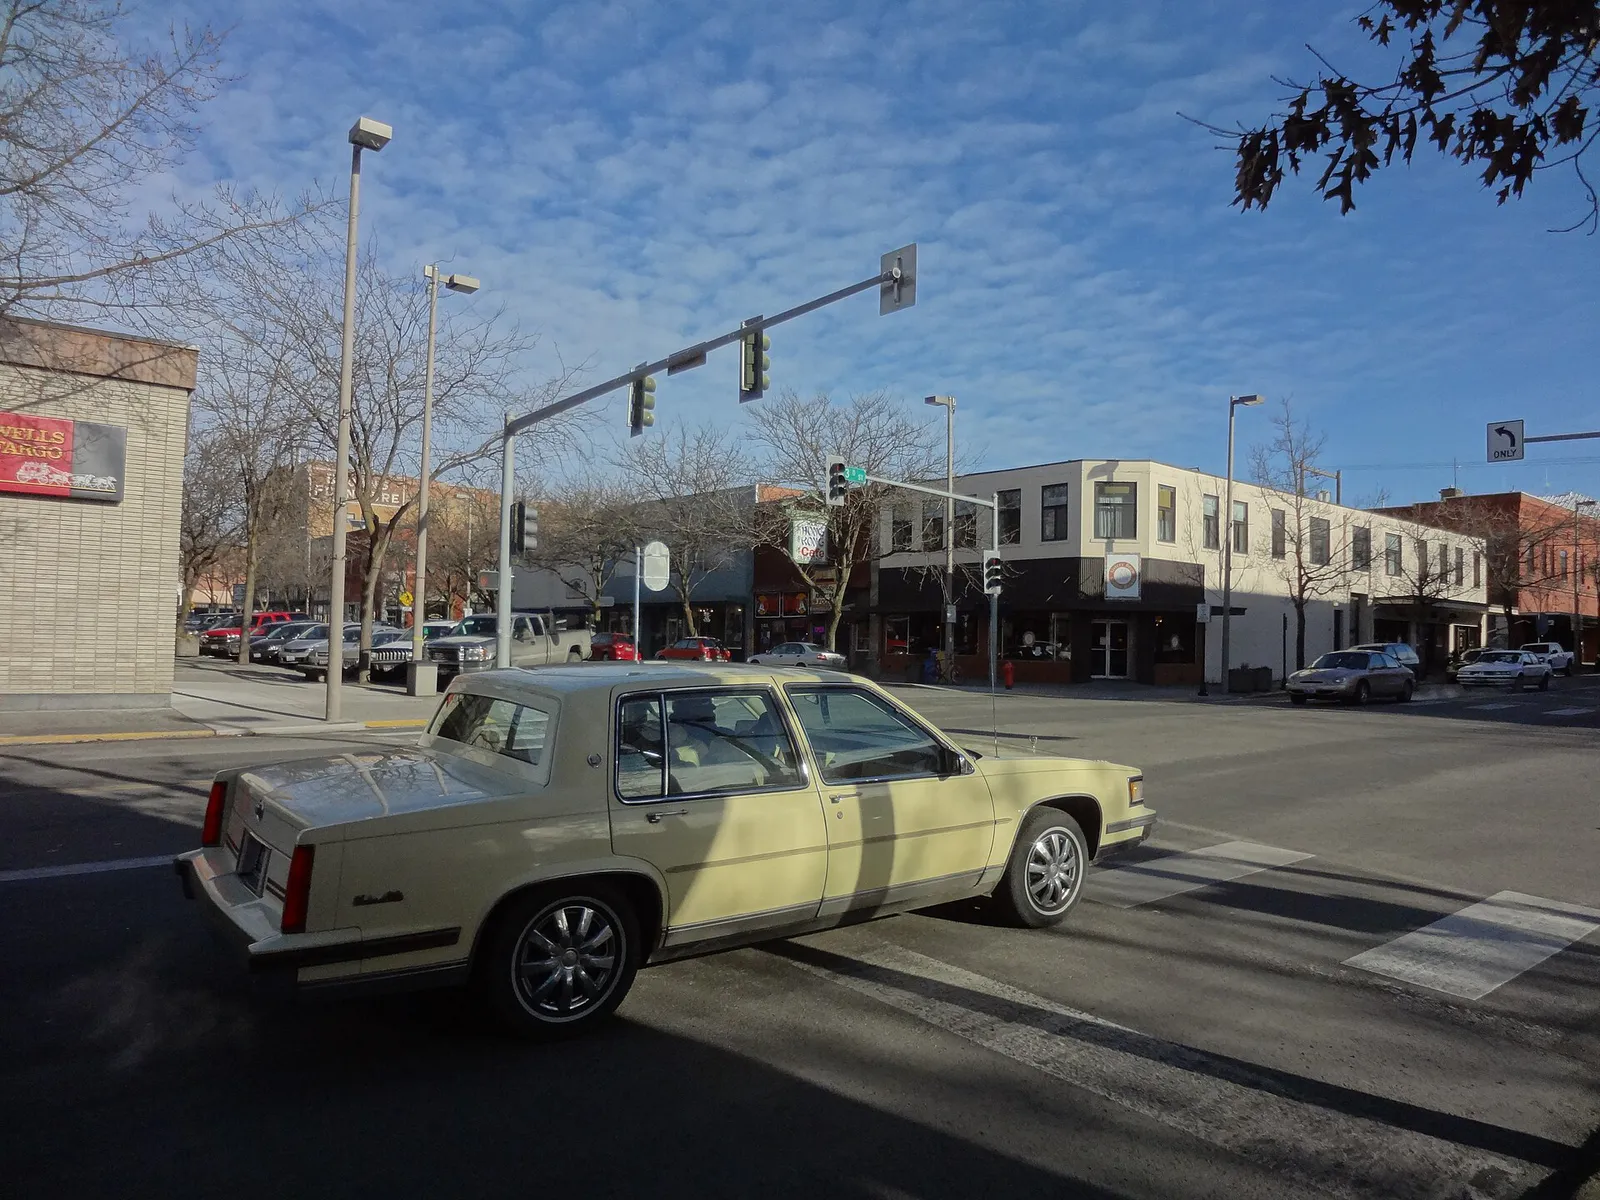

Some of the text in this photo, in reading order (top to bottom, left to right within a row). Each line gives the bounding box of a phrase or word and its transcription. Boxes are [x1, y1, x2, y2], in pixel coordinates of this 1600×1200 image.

[1494, 449, 1516, 458] ONLY
[314, 483, 400, 504] FUNRE
[802, 526, 825, 537] HONG
[802, 536, 825, 547] KONG
[801, 546, 825, 558] Cafe
